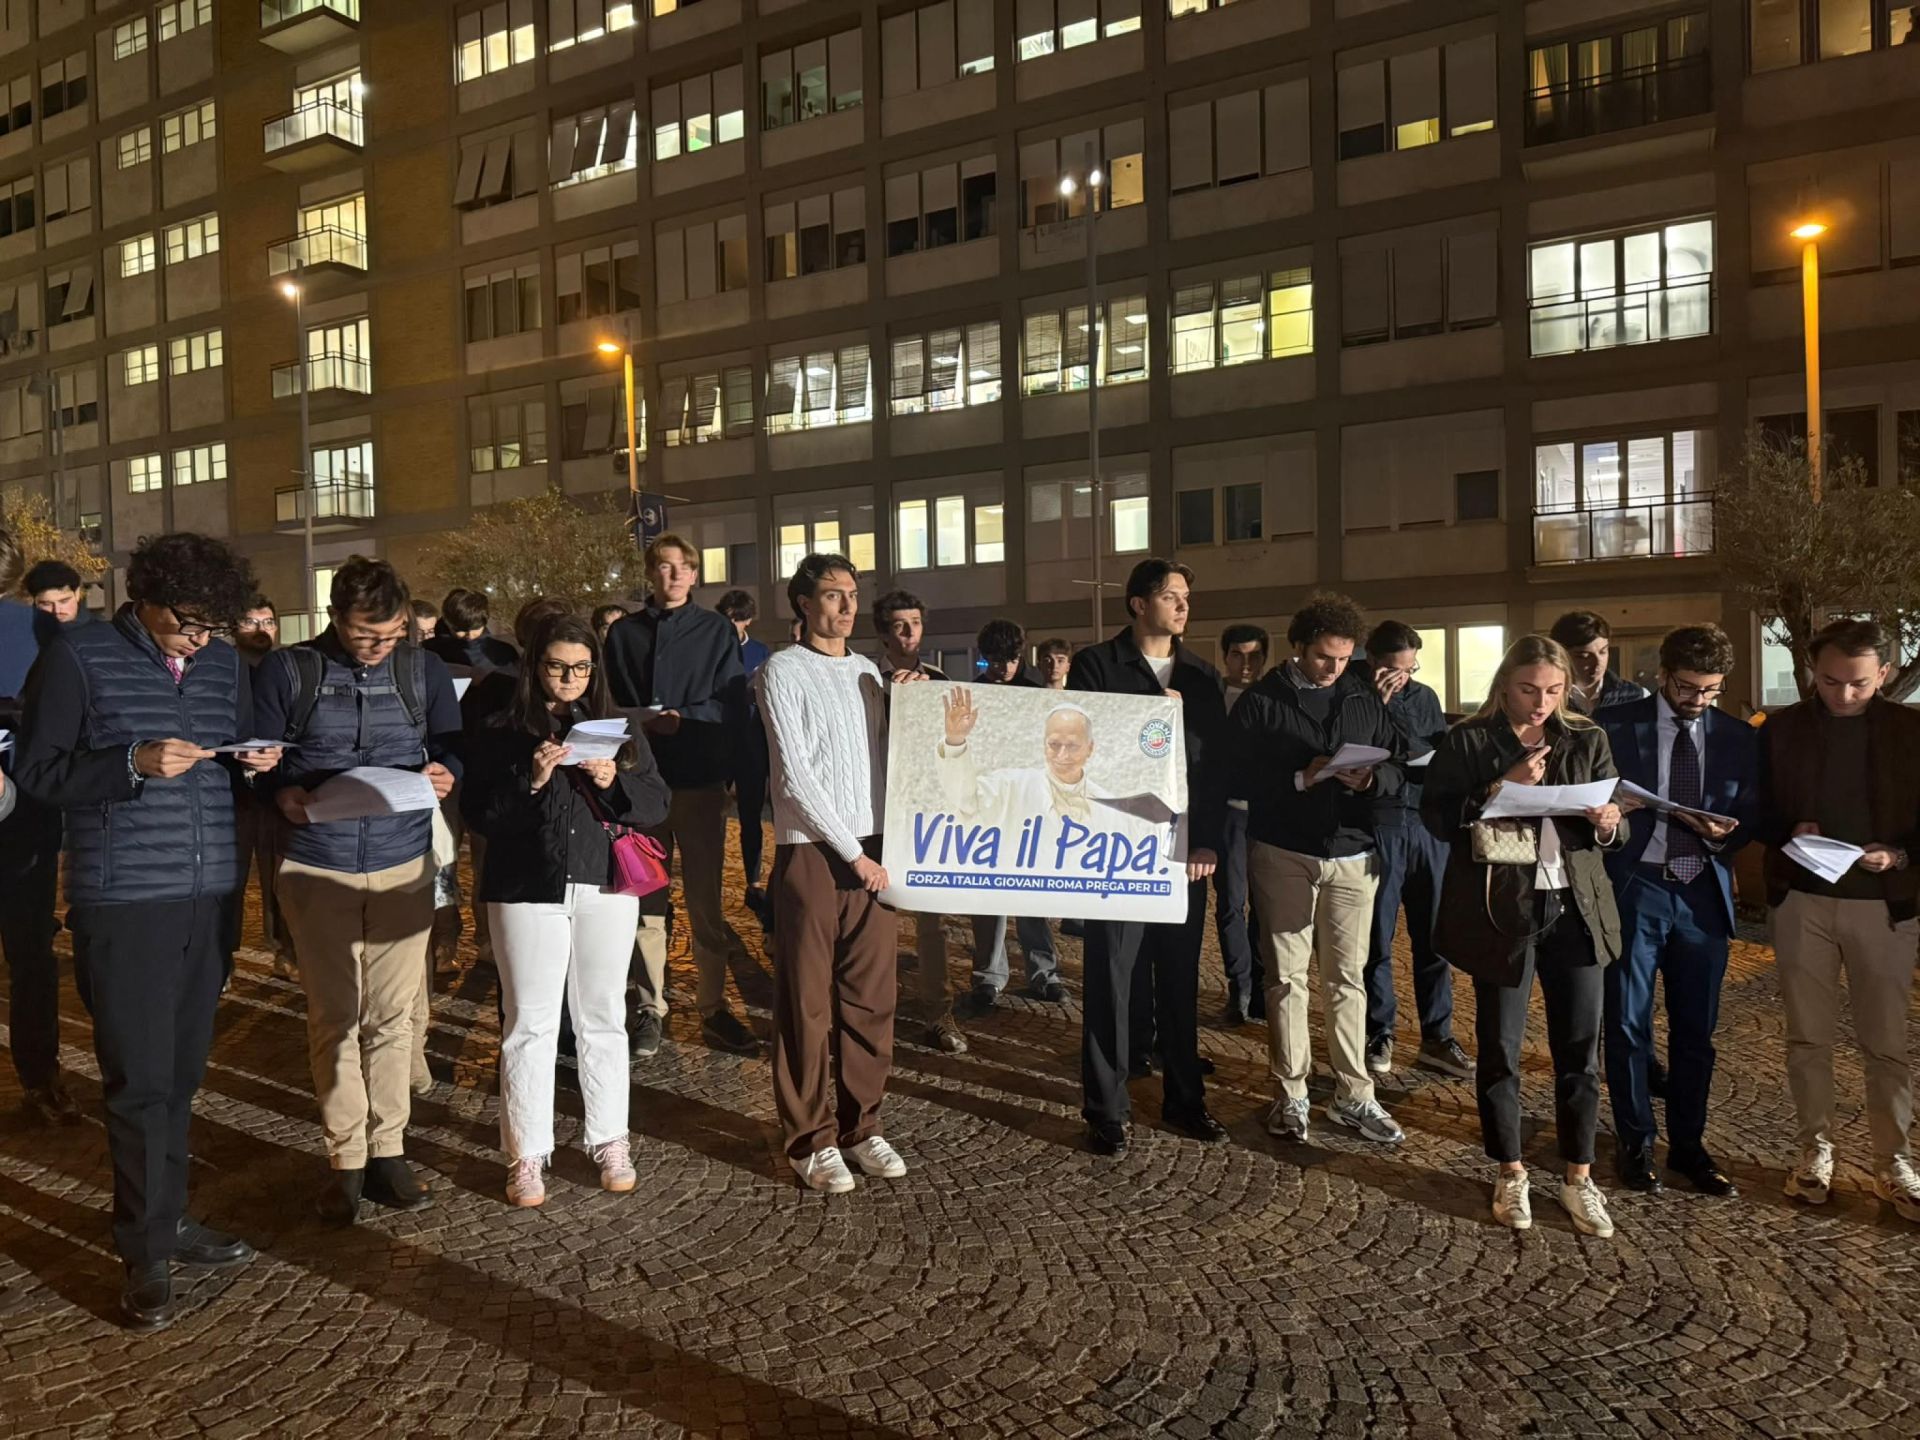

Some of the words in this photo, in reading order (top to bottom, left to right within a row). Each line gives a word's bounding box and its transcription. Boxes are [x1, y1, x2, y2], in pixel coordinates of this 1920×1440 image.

[914, 812, 1001, 869] Viva
[1015, 815, 1043, 868] il
[1055, 815, 1169, 899] Papa.
[907, 873, 950, 885] FORZA
[952, 875, 991, 887] ITALIA
[993, 876, 1044, 889] GIOVANI
[1047, 879, 1083, 890] ROMA
[1086, 880, 1126, 892] PREGA
[1128, 882, 1151, 892] PER
[1153, 882, 1170, 893] LEI
